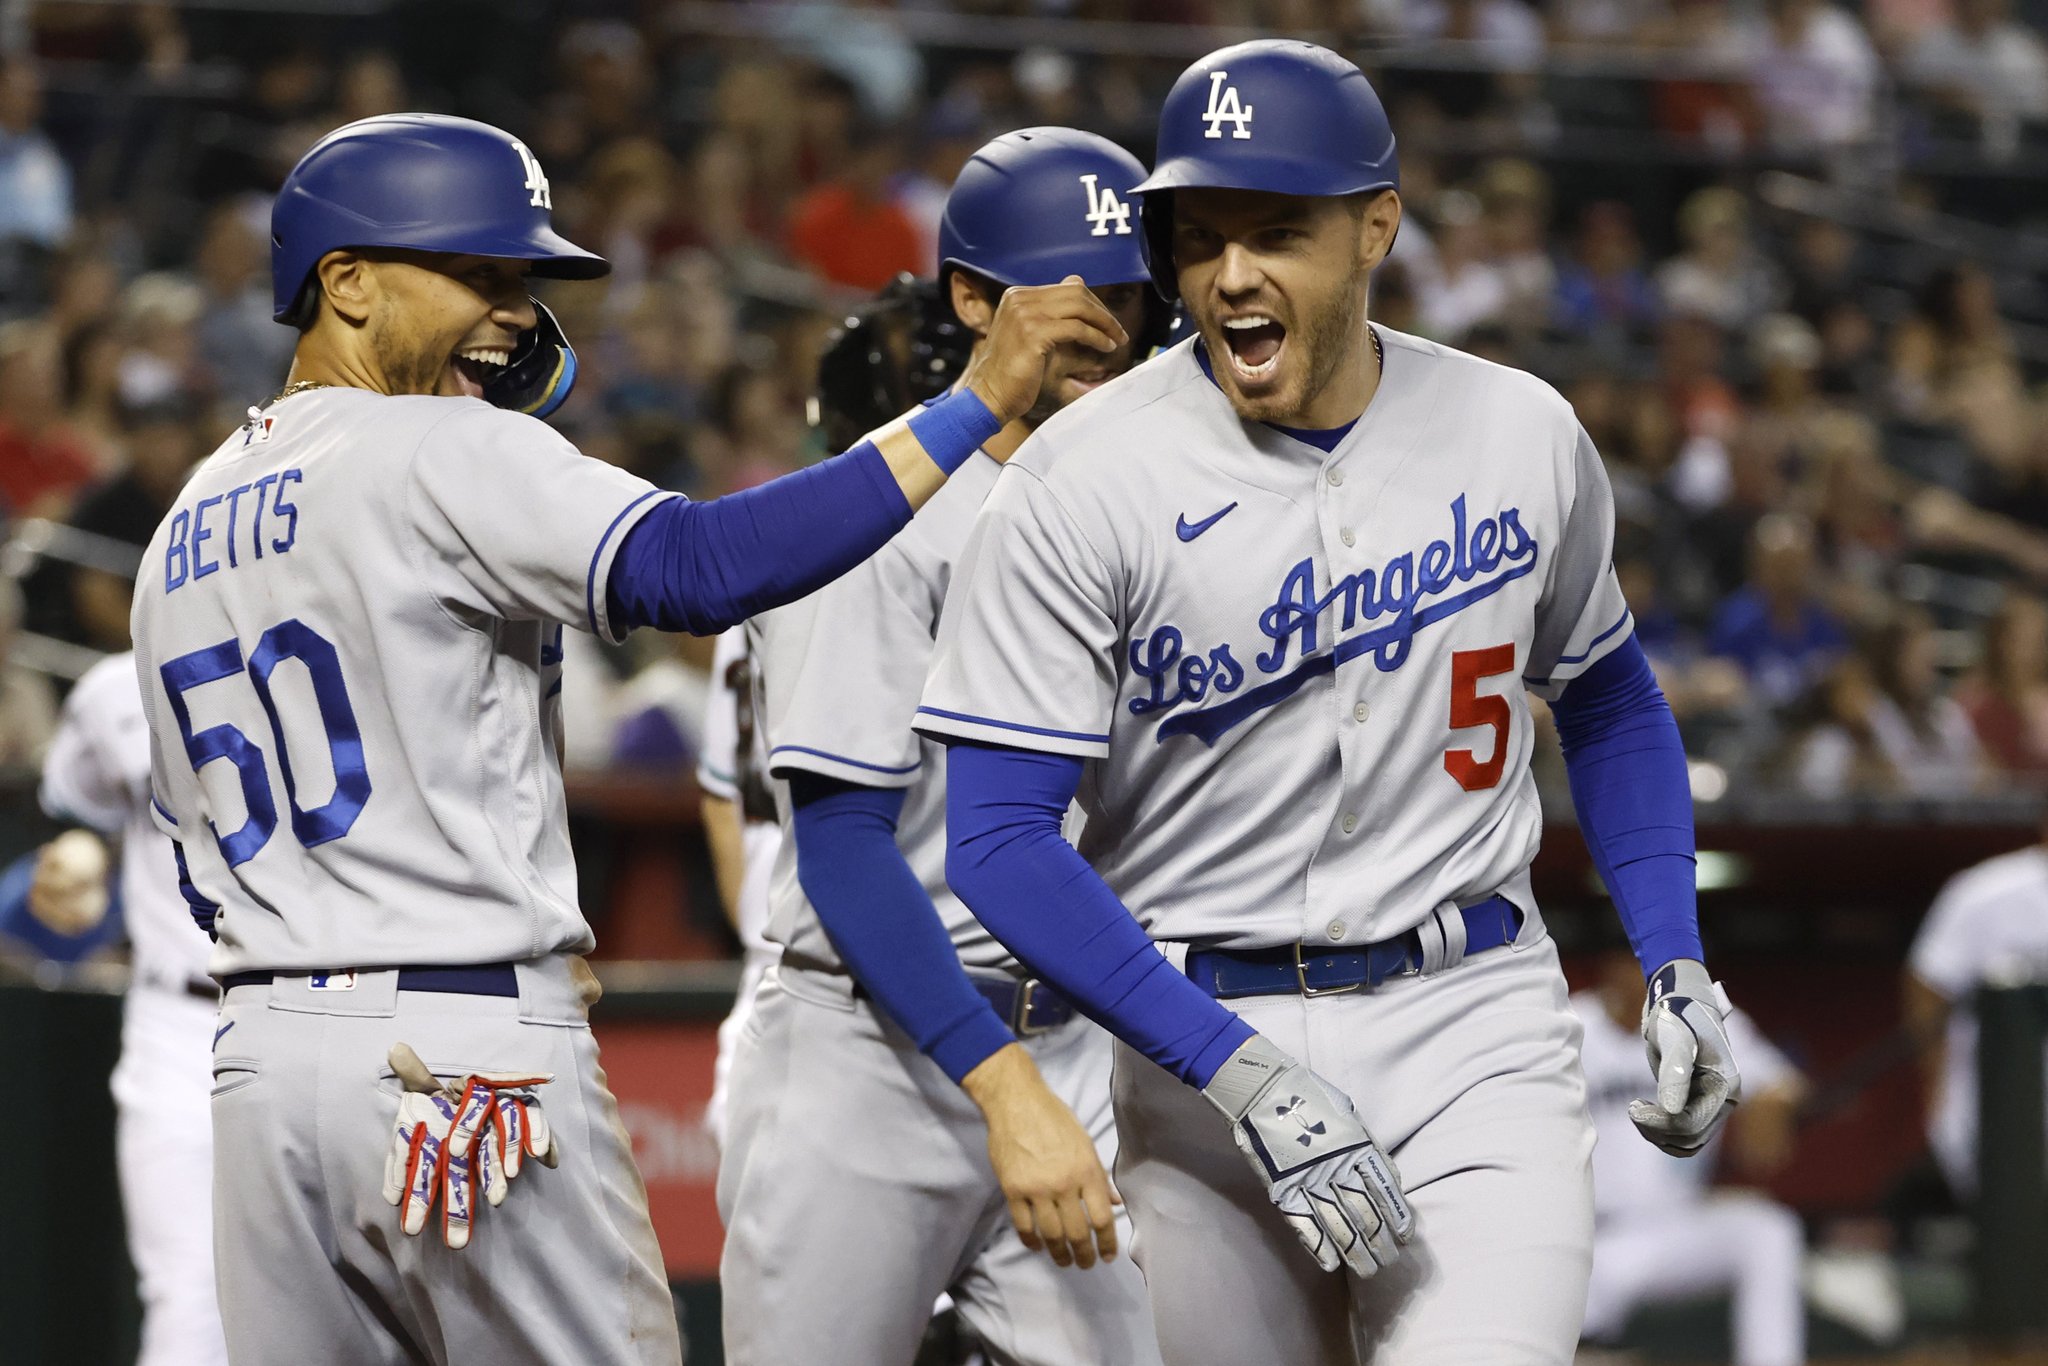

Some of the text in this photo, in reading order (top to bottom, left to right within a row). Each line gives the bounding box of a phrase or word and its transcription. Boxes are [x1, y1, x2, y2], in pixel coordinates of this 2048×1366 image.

[1202, 71, 1253, 139] LA
[511, 143, 552, 210] LA
[1079, 174, 1132, 236] LA
[166, 468, 303, 595] BETTS
[1129, 492, 1538, 715] Los Angeles
[160, 618, 372, 869] 50
[1444, 641, 1516, 792] 5
[1367, 1155, 1406, 1220] UNDER ARMOUR
